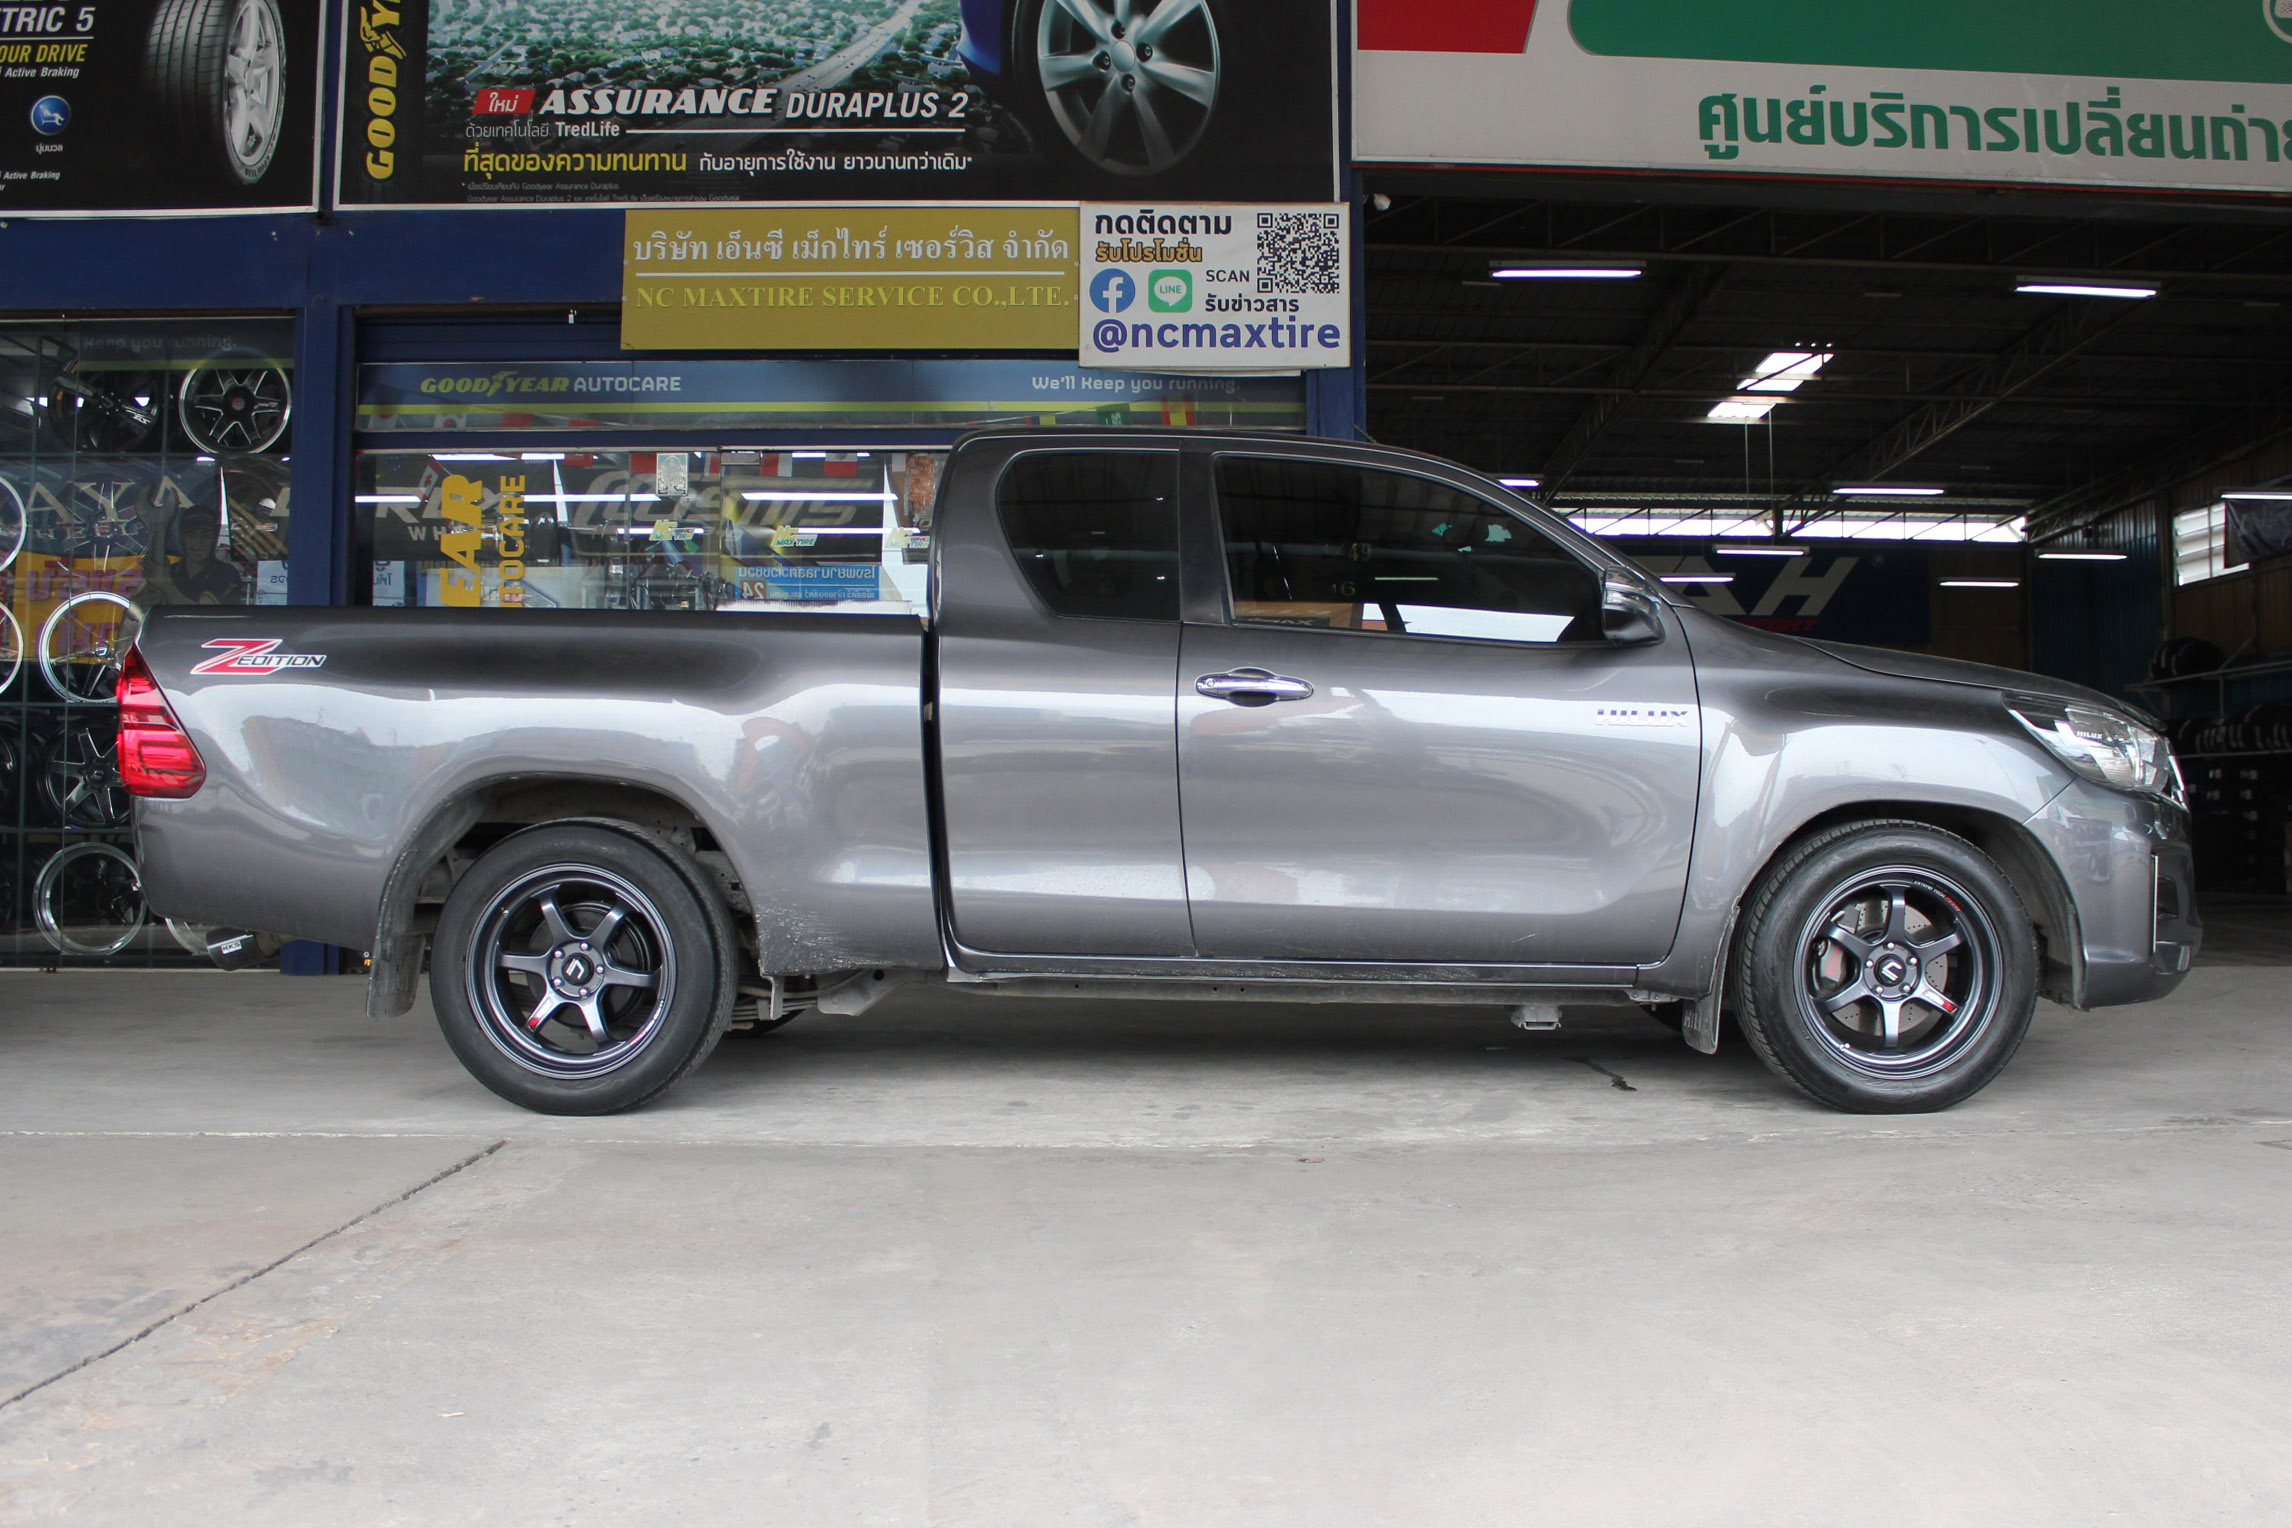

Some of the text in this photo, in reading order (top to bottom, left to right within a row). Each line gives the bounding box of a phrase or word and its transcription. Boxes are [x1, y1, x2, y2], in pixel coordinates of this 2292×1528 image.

[0, 7, 96, 32] TRIC 5
[36, 44, 88, 62] DRIVE
[5, 66, 79, 78] Active Braking
[489, 89, 969, 118] ใหม่ ASSURANCE DURAPLUS 2
[465, 119, 620, 138] ด้วยเทคโนโลยี TredLife
[464, 142, 687, 179] ที่สุดของความทนทาน
[699, 149, 836, 177] กับอายุการใช้งาน
[4, 171, 60, 180] Active Braking
[1095, 209, 1232, 236] กดติดตาม
[633, 230, 708, 260] บริษัท
[716, 228, 784, 260] เอ็นซี
[896, 225, 994, 260] เซอร์วิส
[1003, 229, 1069, 259] จำกัด
[1095, 237, 1203, 263] รับโปรโมชั่น
[1205, 269, 1250, 283] SCAN
[636, 287, 674, 308] NC
[683, 287, 814, 308] MAXTIRE
[822, 287, 944, 308] SERVICE
[1159, 285, 1182, 295] LINE
[1205, 293, 1300, 313] รับข่าวสาร
[1093, 315, 1341, 353] @ncmaxtire
[420, 371, 682, 397] GOODYEAR AUTOCARE
[1131, 378, 1163, 394] you
[499, 474, 526, 607] TOCARE
[190, 638, 326, 675] Z EDITION
[2076, 730, 2104, 740] HILUX
